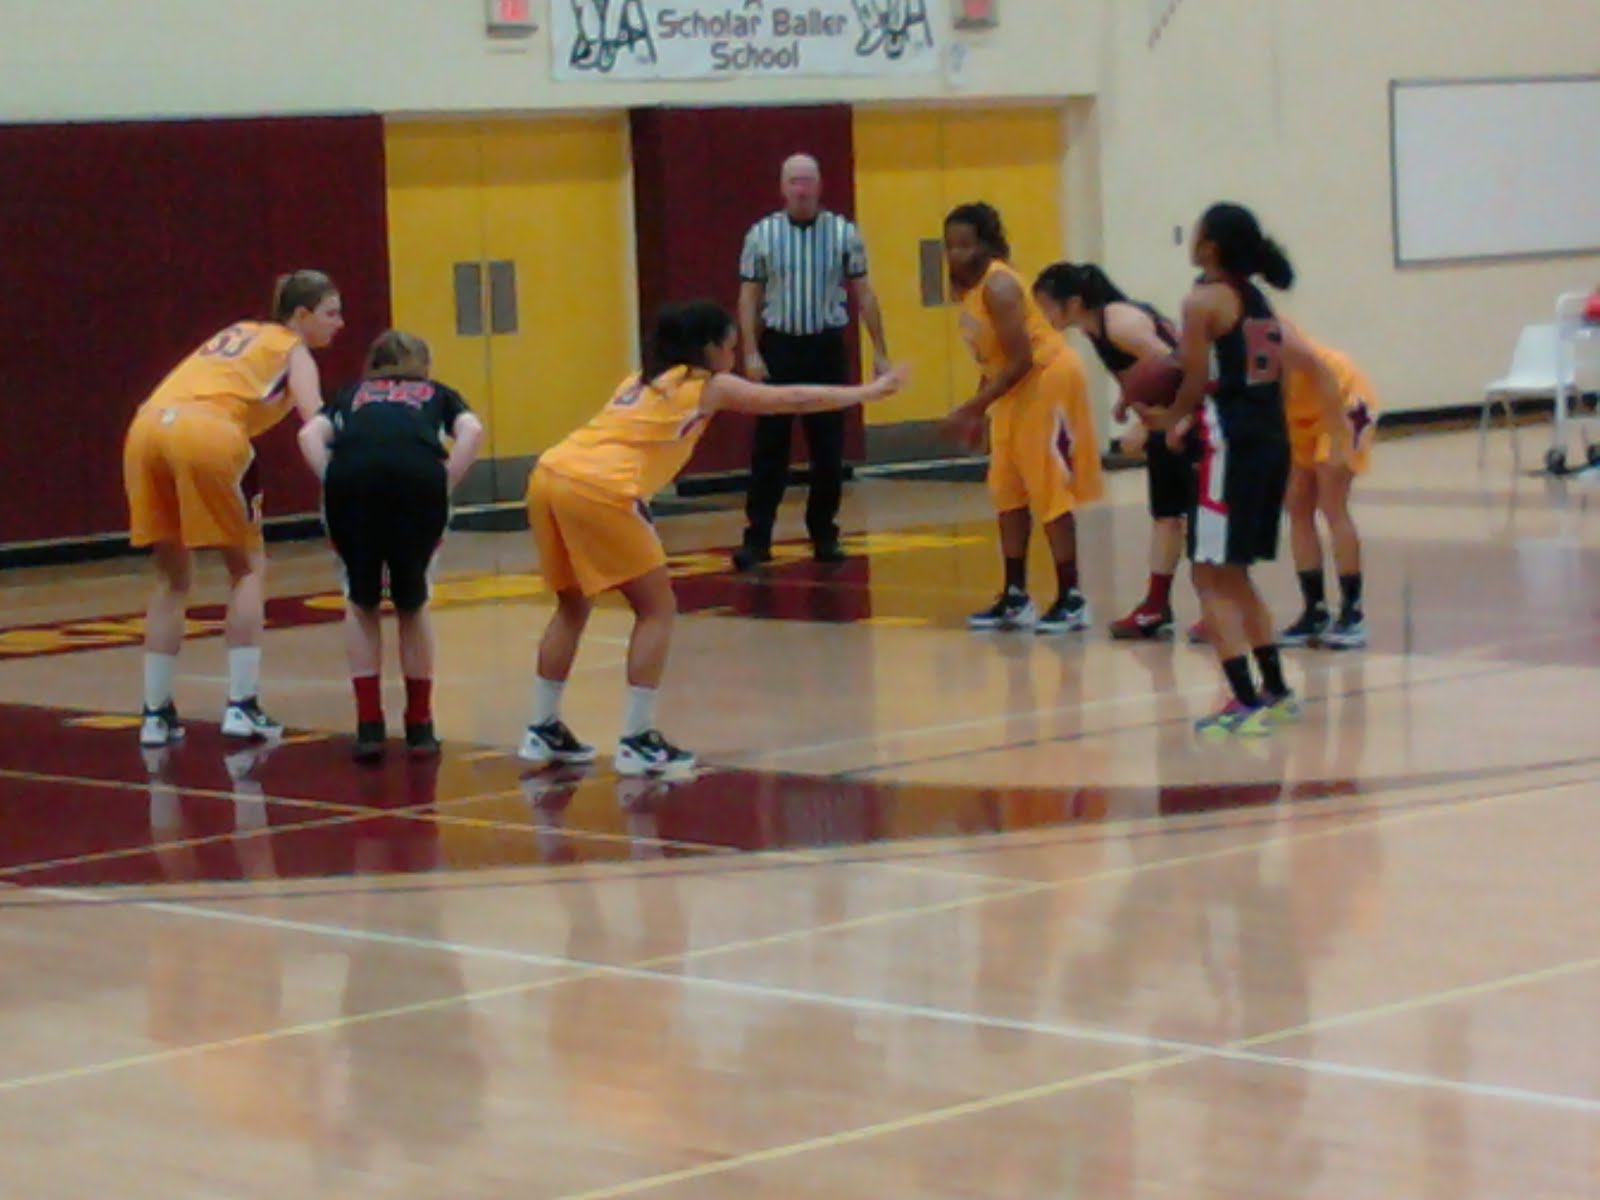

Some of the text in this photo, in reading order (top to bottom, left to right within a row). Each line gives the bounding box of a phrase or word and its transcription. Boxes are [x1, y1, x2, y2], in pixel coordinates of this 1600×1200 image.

[656, 7, 848, 39] Scholar Baller
[710, 40, 799, 71] School
